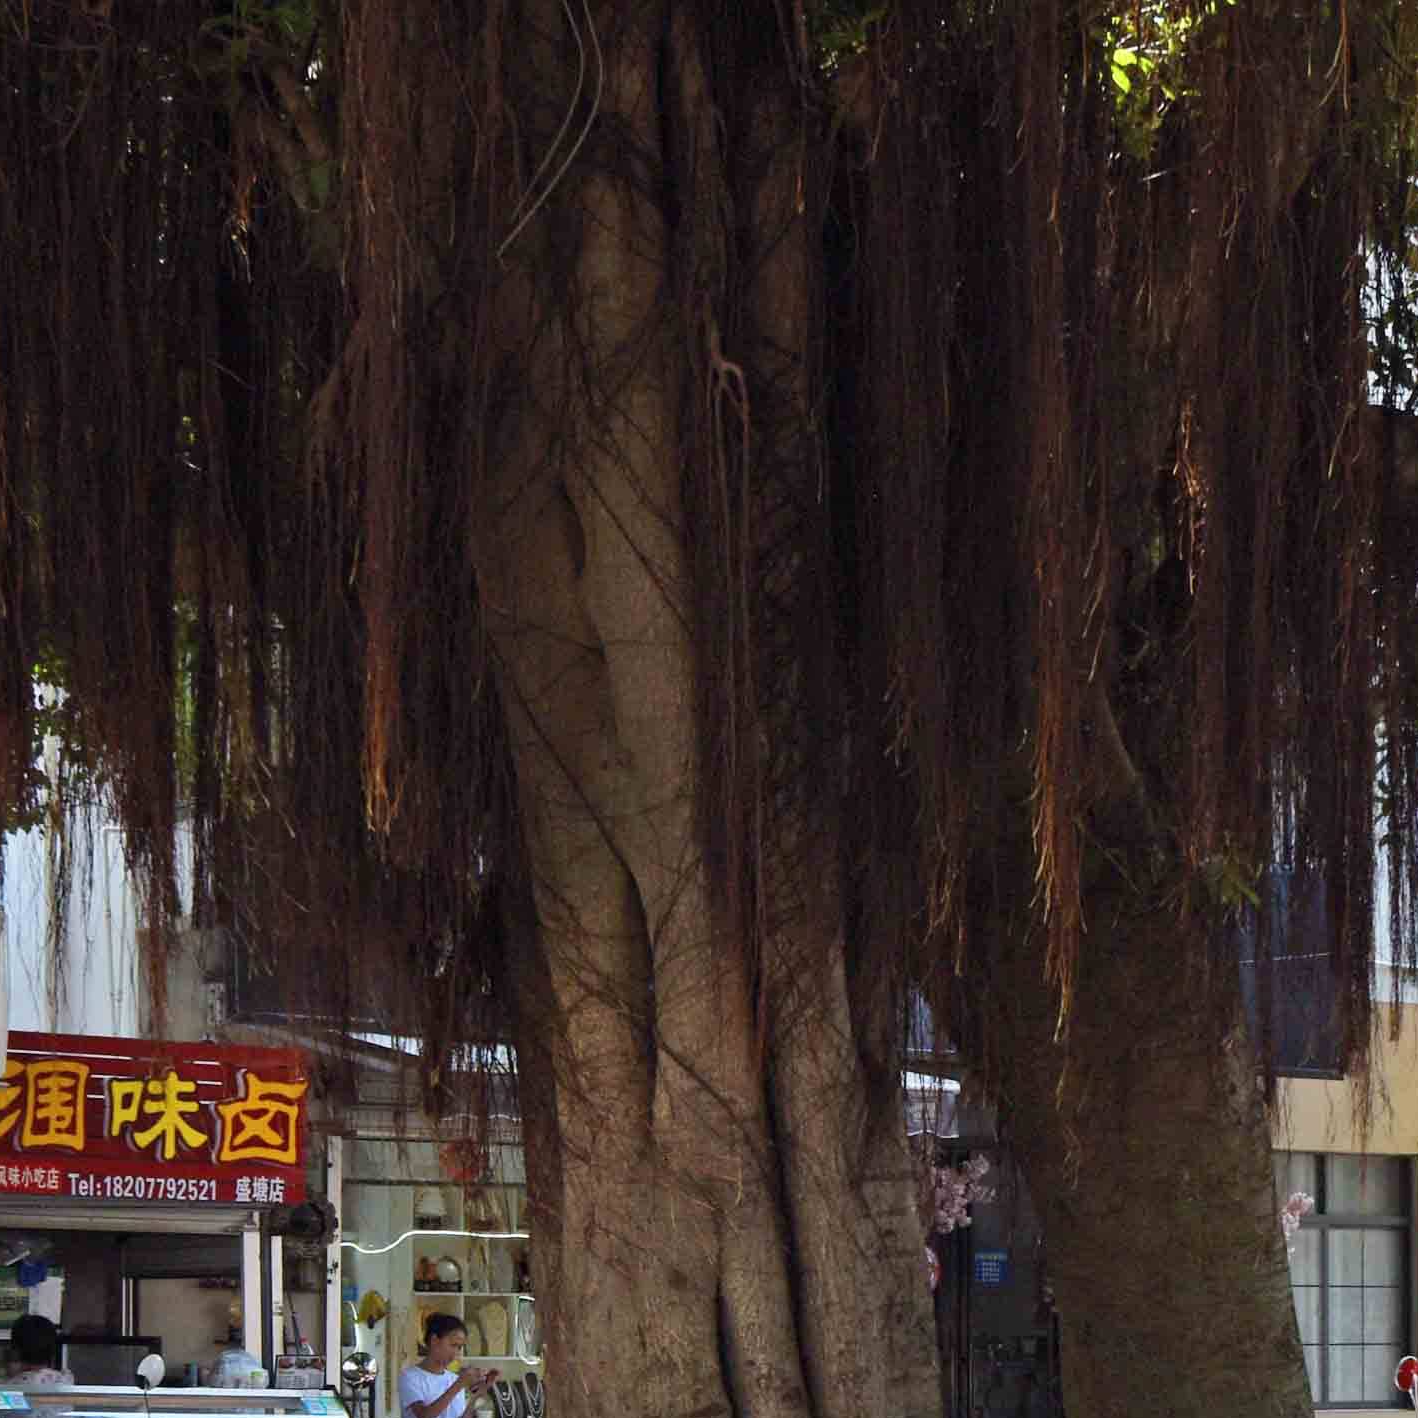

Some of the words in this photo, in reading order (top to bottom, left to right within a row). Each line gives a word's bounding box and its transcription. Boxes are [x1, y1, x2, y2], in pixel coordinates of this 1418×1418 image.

[68, 1173, 217, 1201] Tel:18207792521
[235, 1176, 285, 1203] 盛塘店
